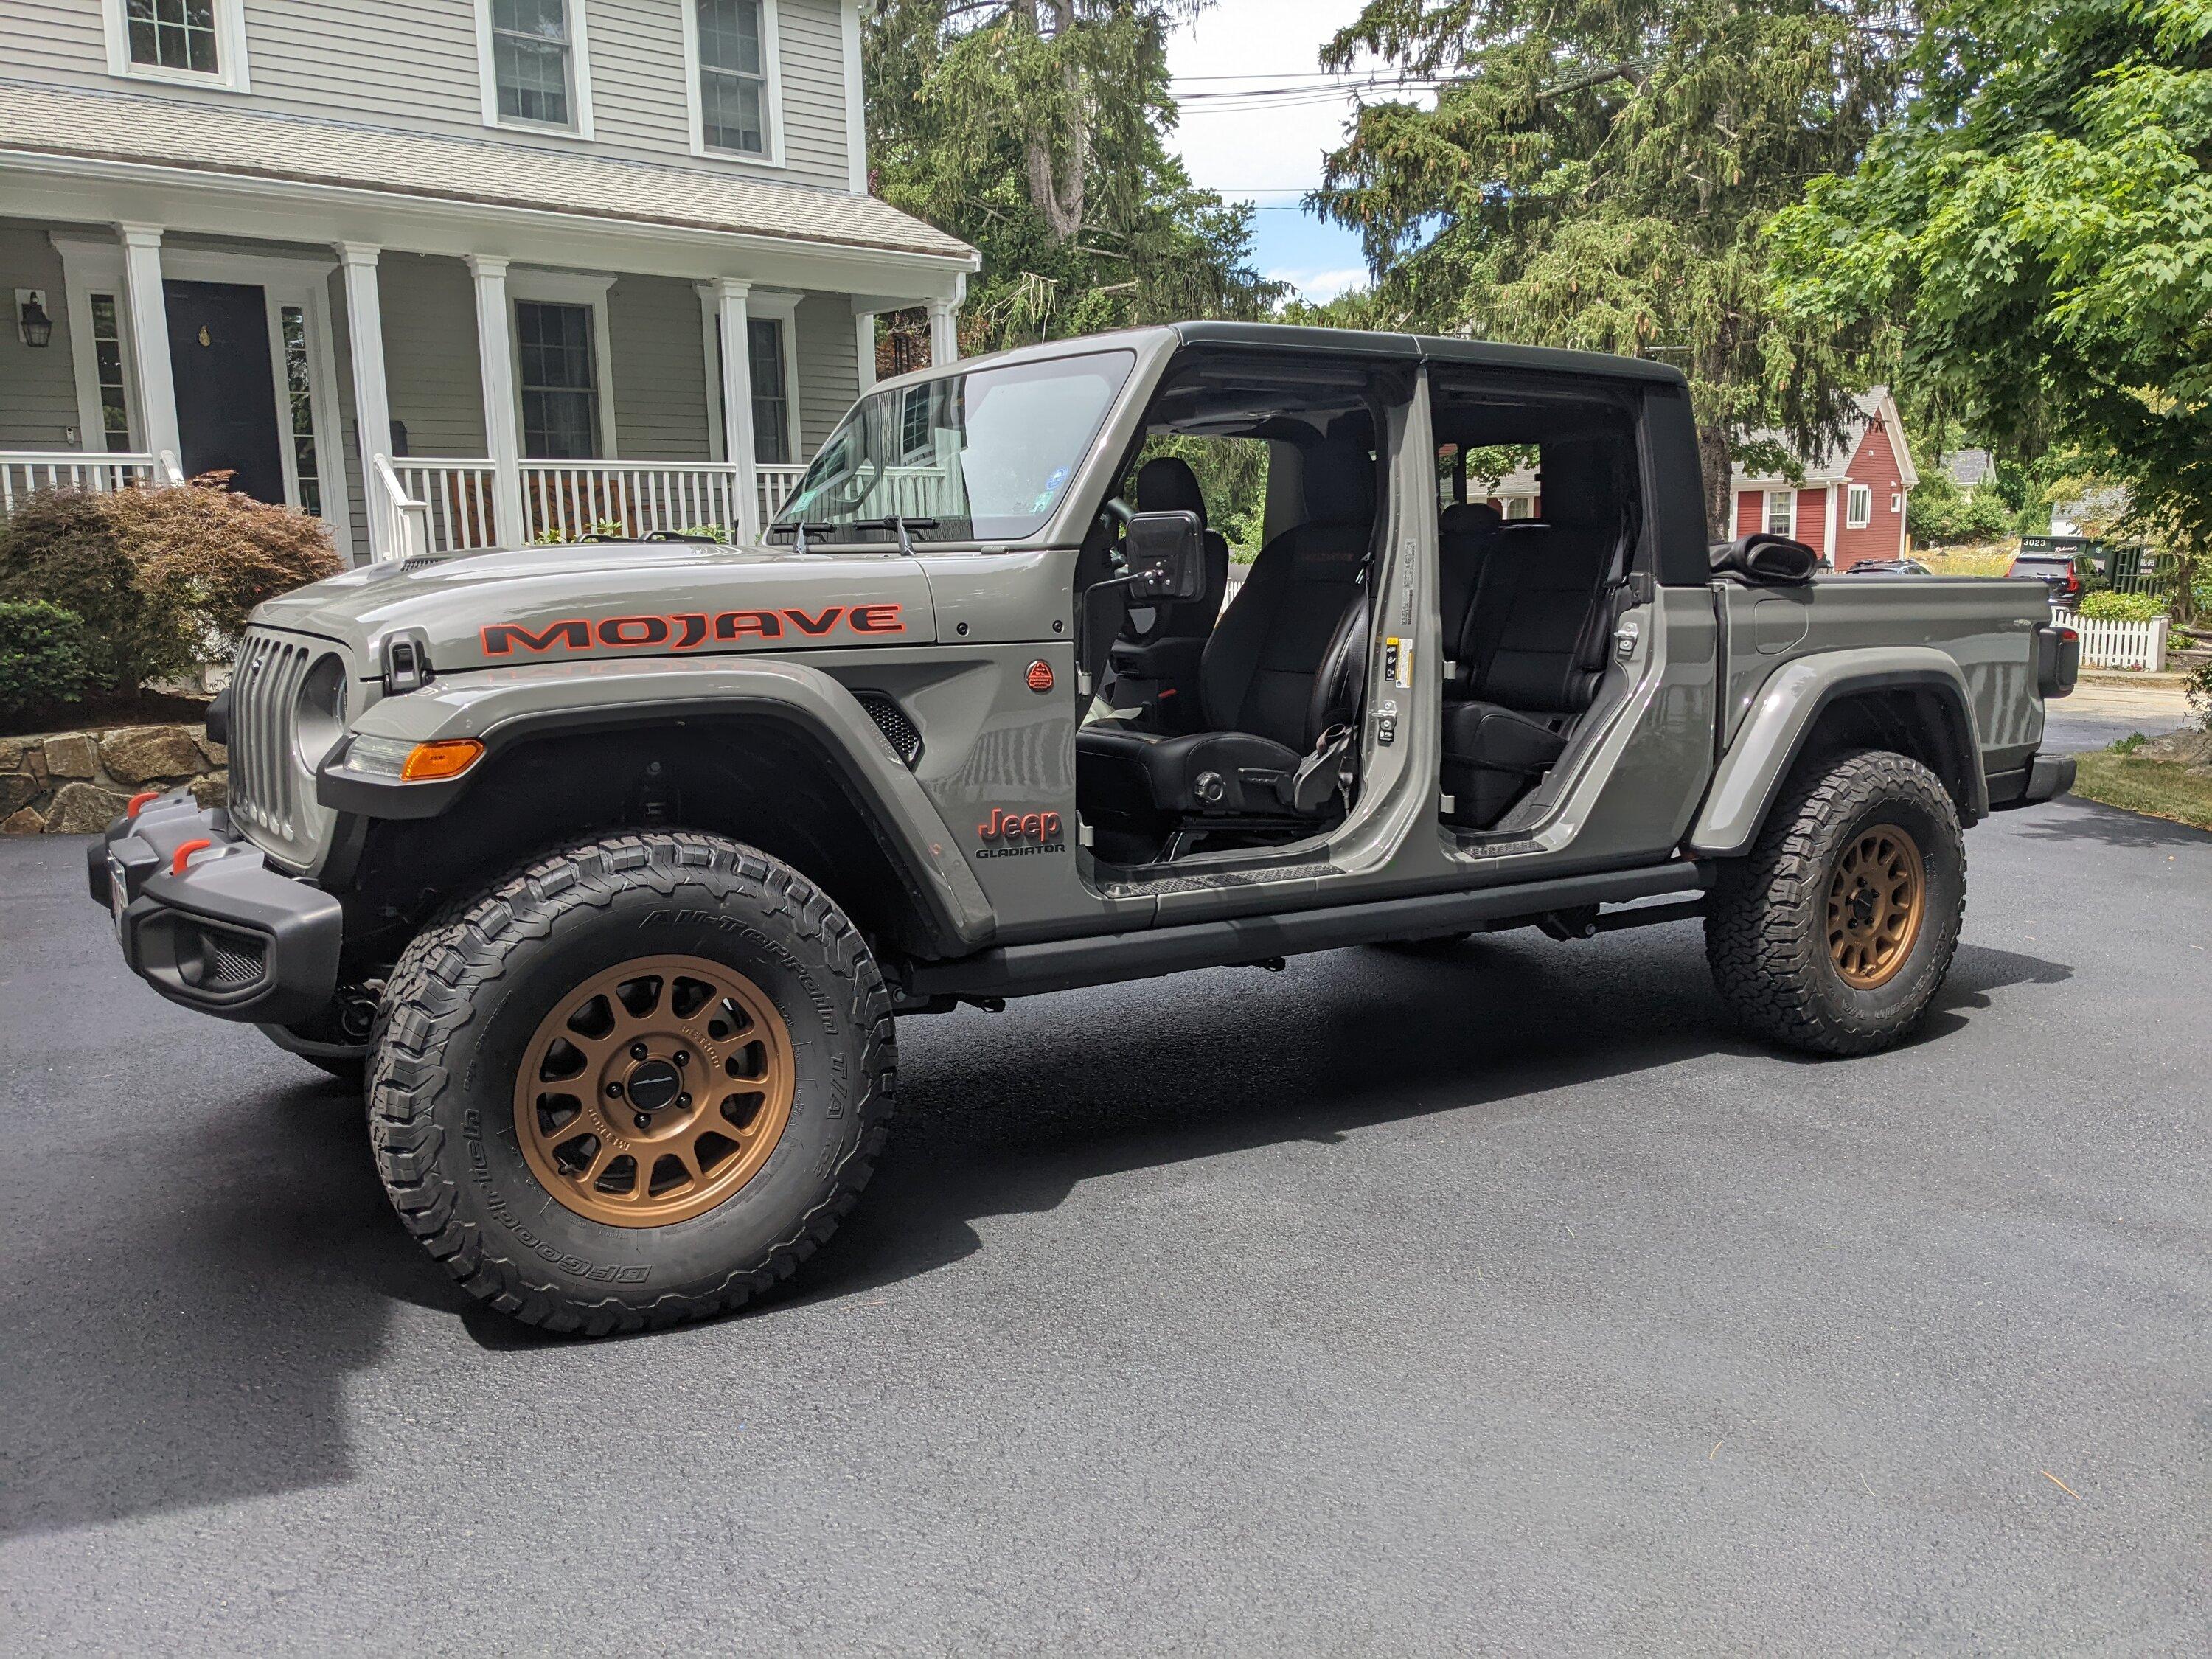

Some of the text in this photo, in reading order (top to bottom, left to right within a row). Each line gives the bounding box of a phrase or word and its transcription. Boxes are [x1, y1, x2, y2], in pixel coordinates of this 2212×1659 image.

[480, 604, 907, 657] MOJAVE
[978, 808, 1062, 842] Jeep
[975, 844, 1065, 859] GLADIATOR
[639, 910, 838, 1034] All-Terrain
[827, 1052, 848, 1119] T/A
[588, 1107, 630, 1151] METHOD
[461, 1108, 653, 1283] BFGoodrich
